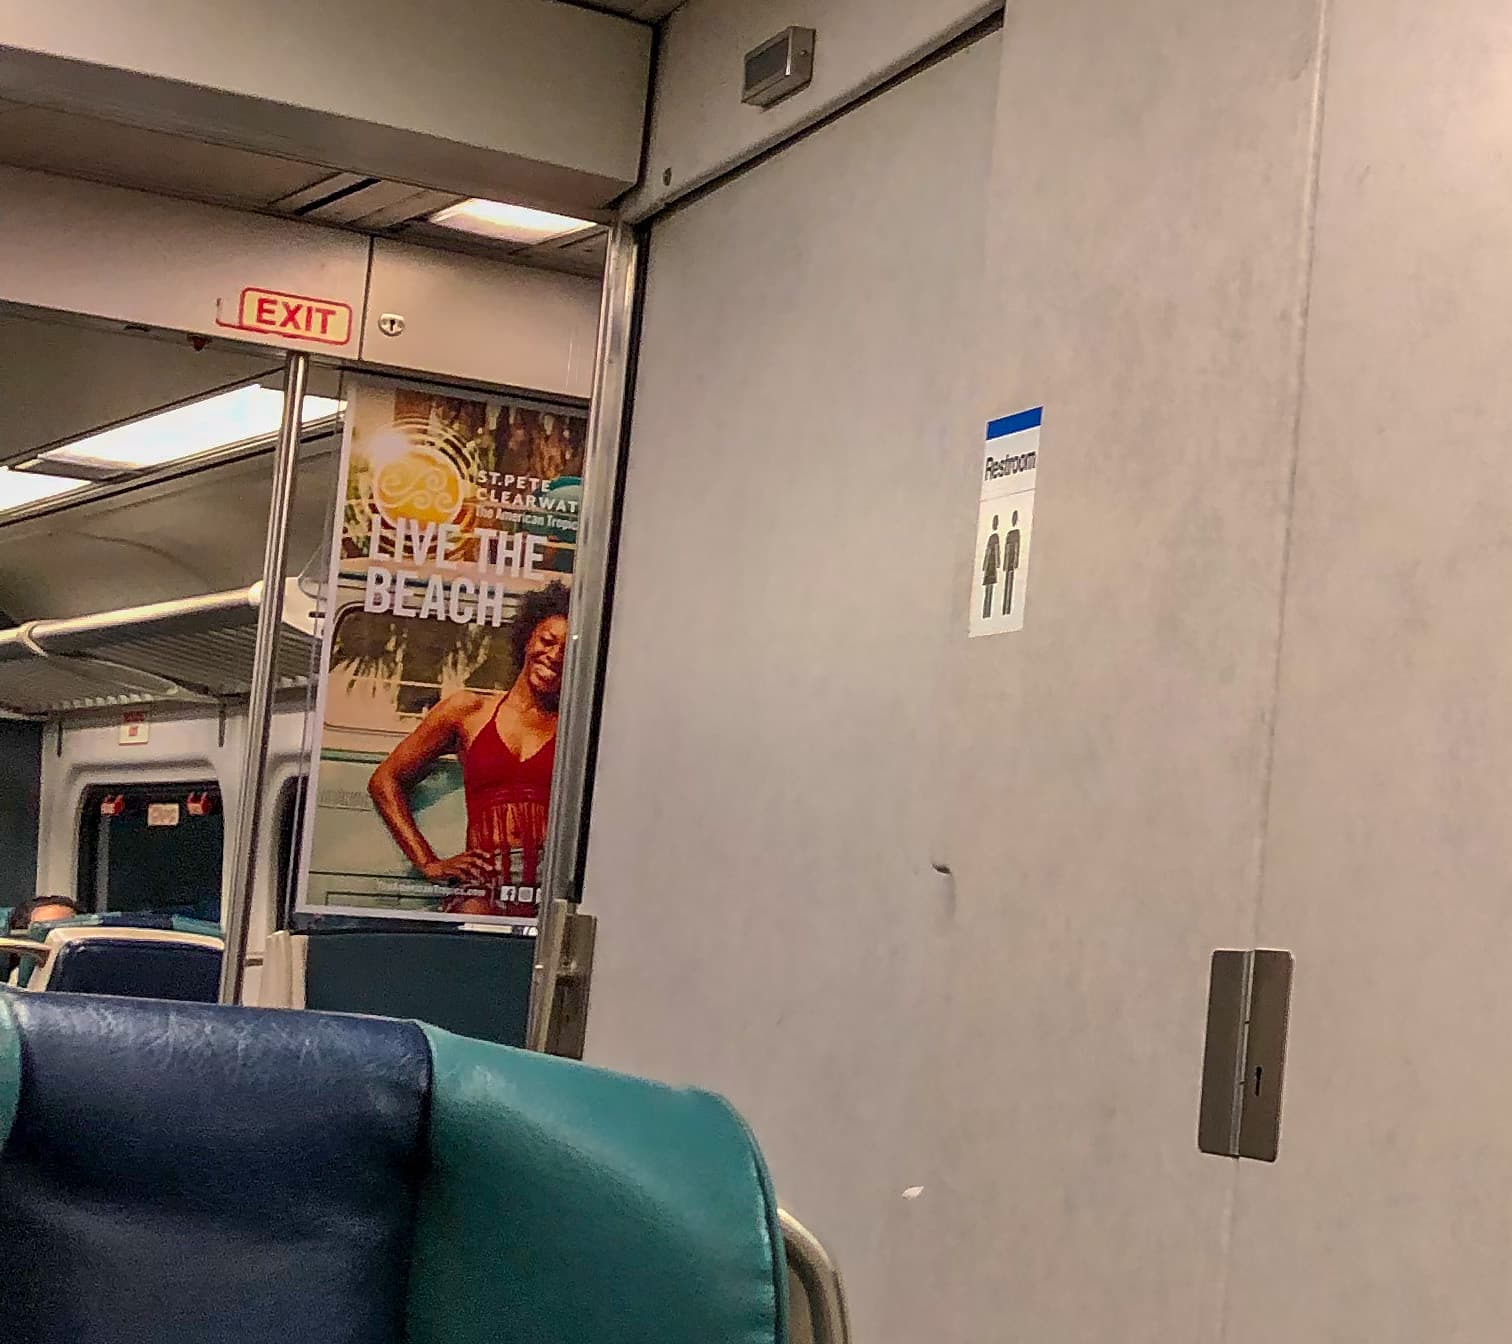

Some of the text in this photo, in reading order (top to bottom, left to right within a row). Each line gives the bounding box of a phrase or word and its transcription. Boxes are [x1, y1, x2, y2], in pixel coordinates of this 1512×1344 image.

[256, 297, 337, 335] EXIT
[984, 450, 1036, 481] Restroom
[496, 508, 545, 526] American
[369, 513, 549, 580] LIVE THE
[364, 566, 504, 628] BEACH
